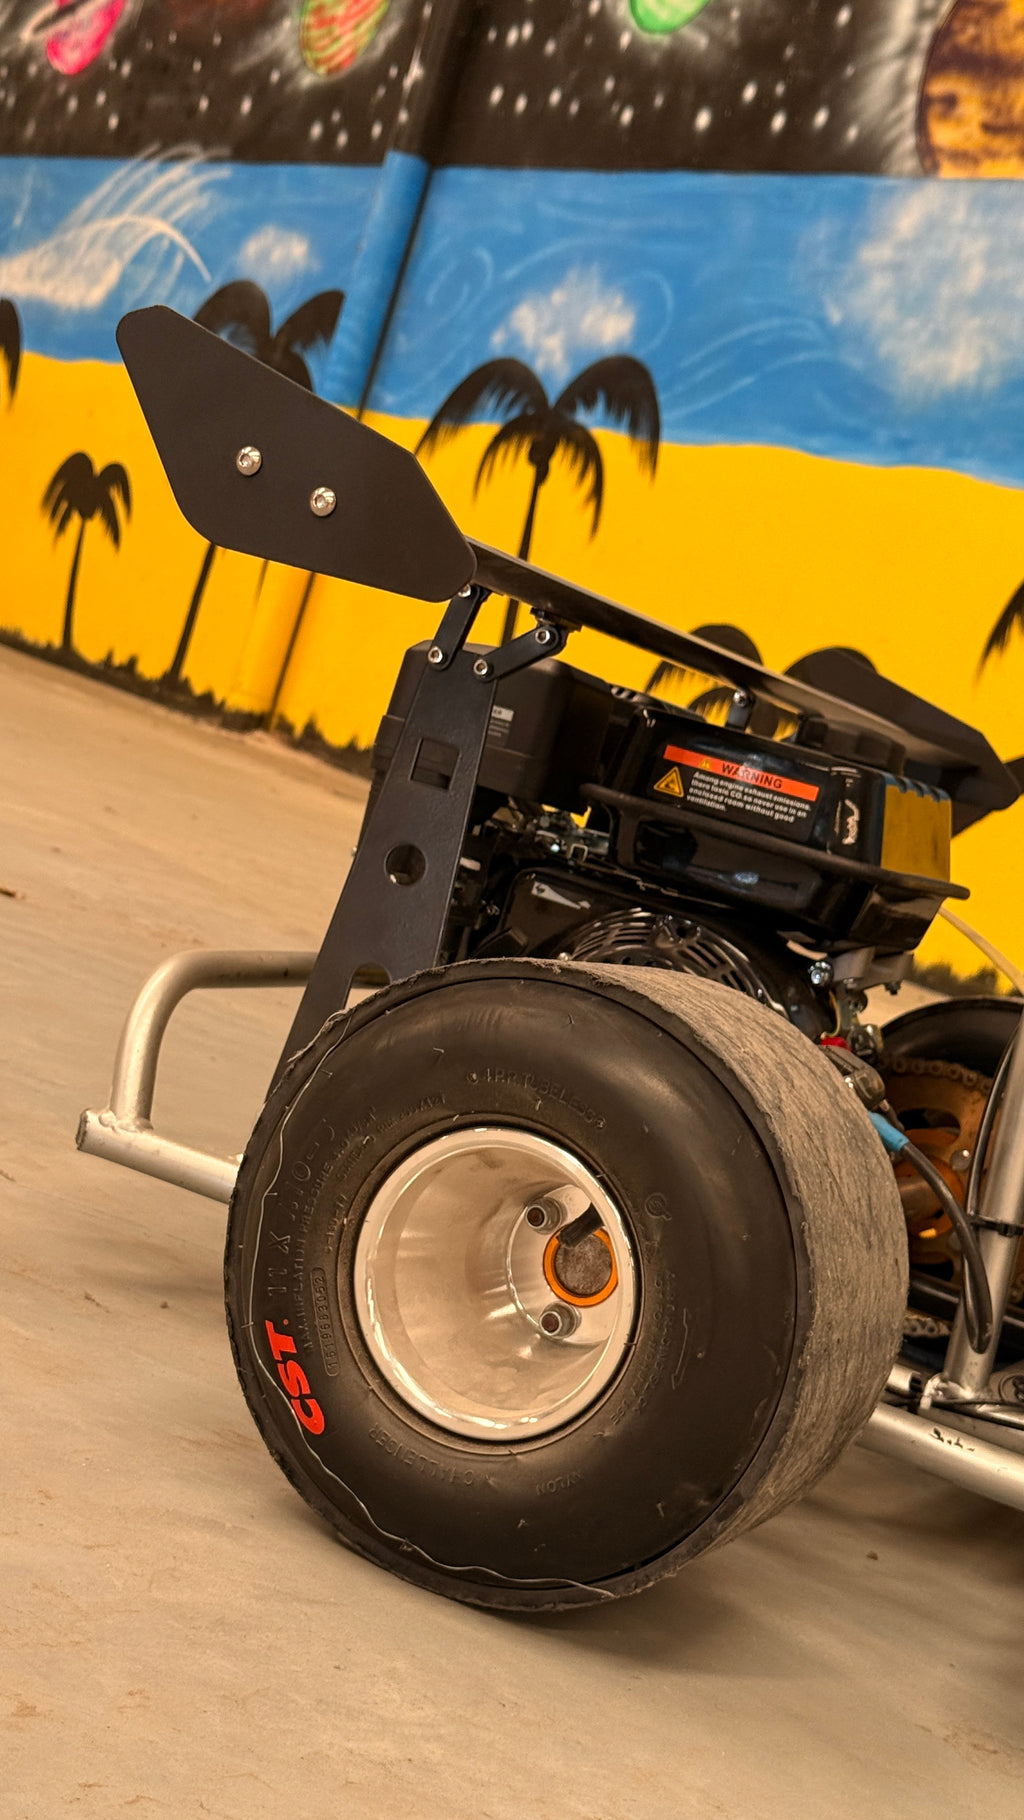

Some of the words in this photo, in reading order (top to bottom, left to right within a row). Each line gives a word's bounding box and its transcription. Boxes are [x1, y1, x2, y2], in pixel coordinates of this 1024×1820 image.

[693, 771, 719, 784] Among
[719, 779, 744, 791] engine
[744, 786, 773, 799] exhaust
[721, 762, 783, 789] WARNING
[688, 787, 724, 801] enclosed
[723, 798, 744, 807] room
[744, 803, 774, 816] without
[773, 812, 794, 823] good
[752, 798, 774, 808] never
[774, 804, 787, 812] use
